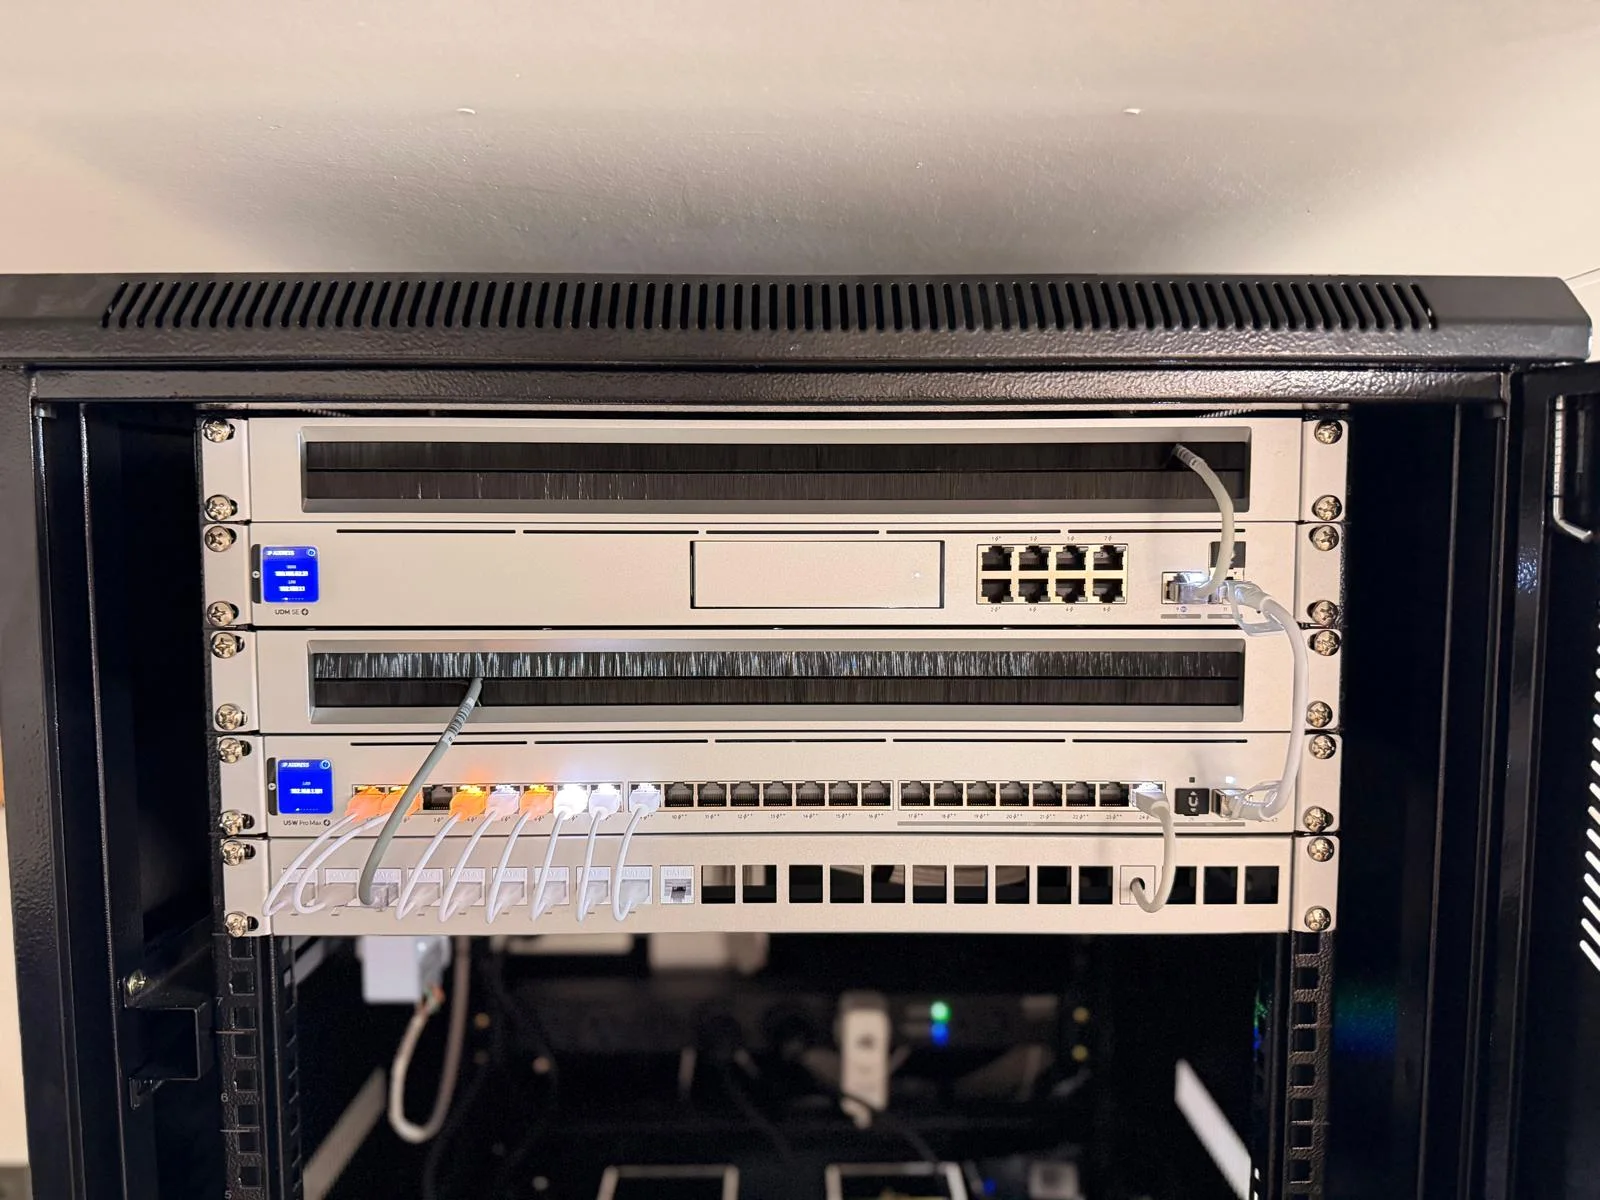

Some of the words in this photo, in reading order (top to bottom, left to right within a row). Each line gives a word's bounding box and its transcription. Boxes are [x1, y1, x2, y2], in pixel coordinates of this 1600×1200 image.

[215, 996, 223, 1006] 7
[220, 1092, 229, 1103] 6
[224, 1189, 233, 1200] 5
